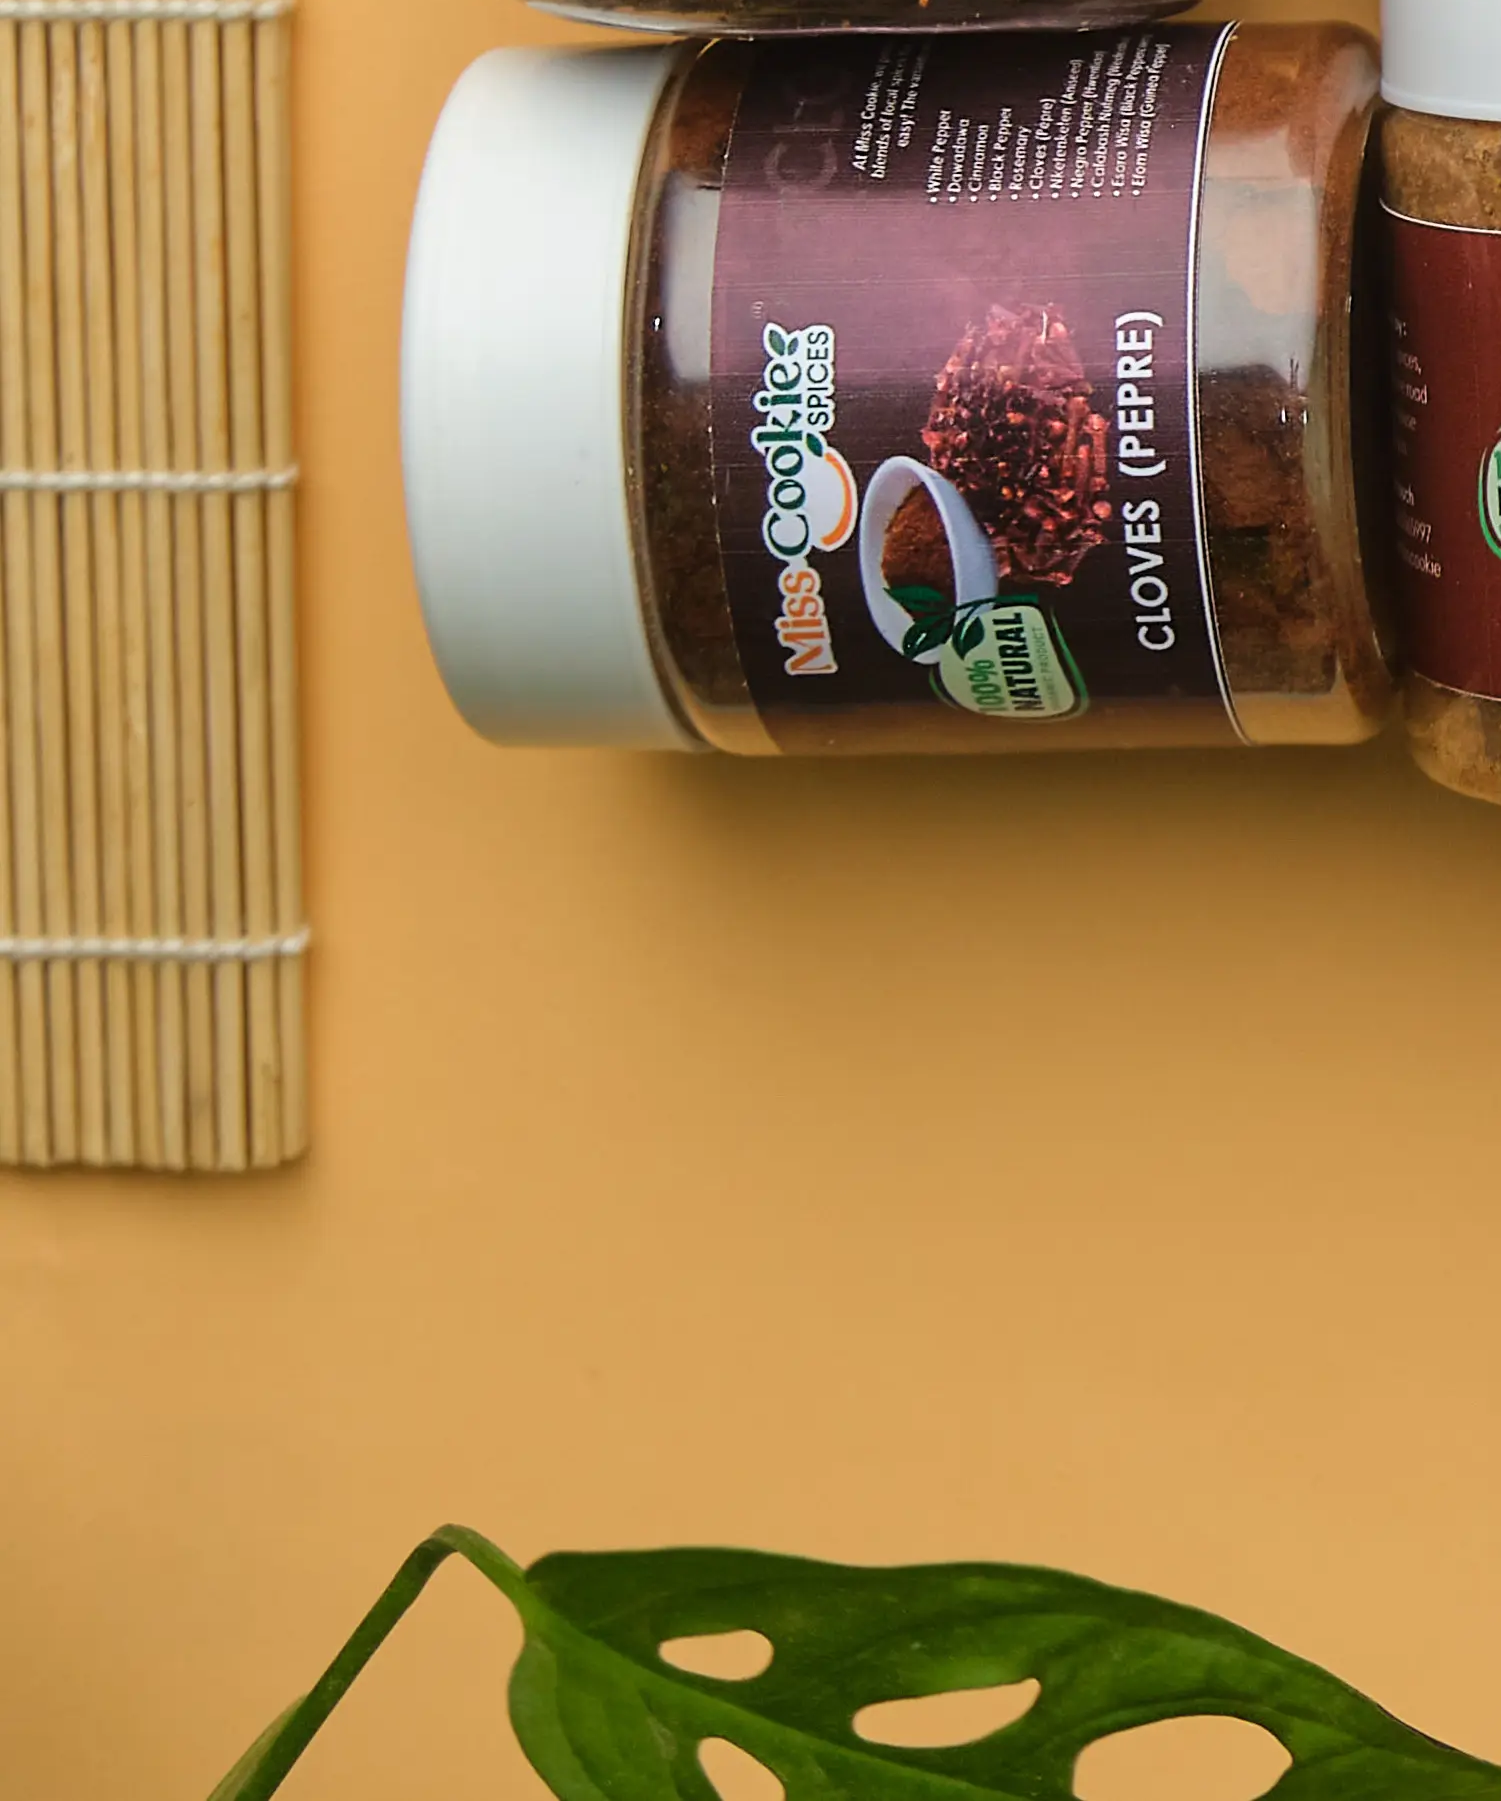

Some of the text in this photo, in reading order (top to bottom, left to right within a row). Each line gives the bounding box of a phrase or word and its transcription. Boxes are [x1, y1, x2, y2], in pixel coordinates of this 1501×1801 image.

[969, 125, 989, 192] Cinnamon
[1010, 126, 1031, 190] Rosemary
[807, 331, 829, 426] SPICES
[756, 362, 832, 670] Miss Cookie
[1115, 311, 1175, 651] CLOVES (PEPRE)
[965, 659, 1006, 713] 100%
[992, 613, 1045, 711] NATURAL
